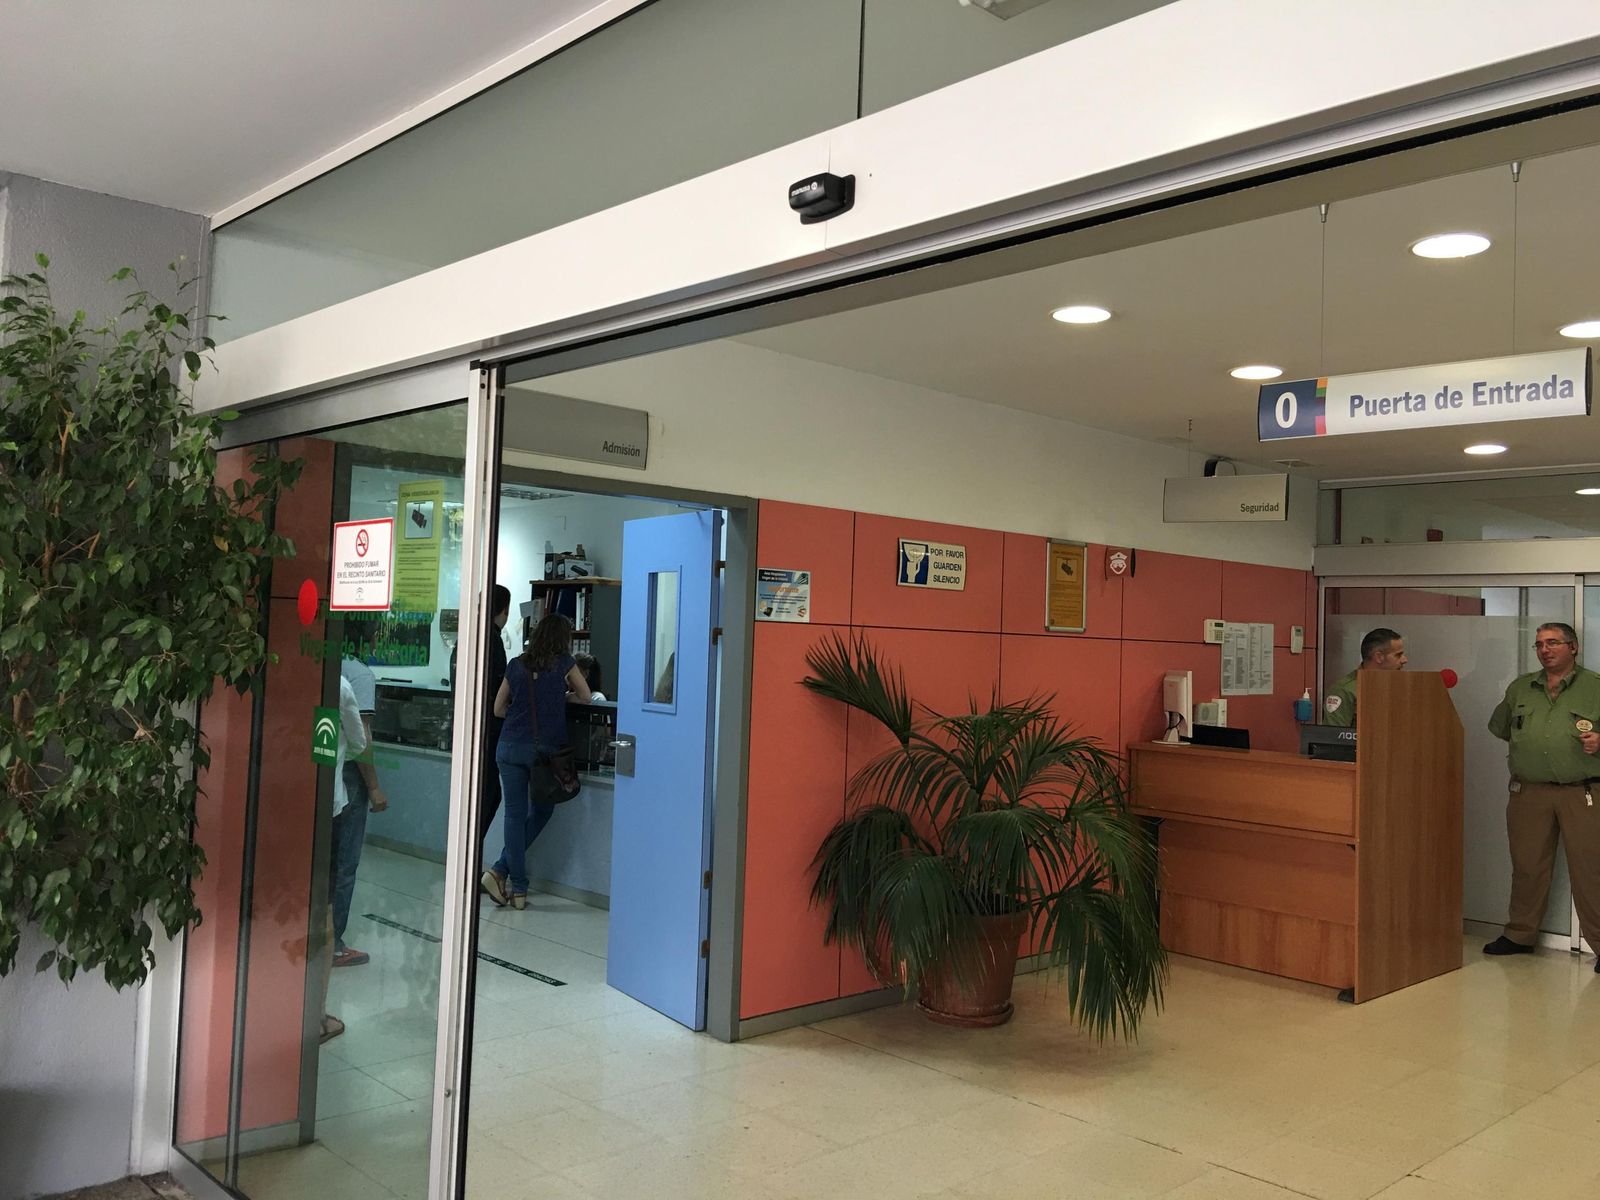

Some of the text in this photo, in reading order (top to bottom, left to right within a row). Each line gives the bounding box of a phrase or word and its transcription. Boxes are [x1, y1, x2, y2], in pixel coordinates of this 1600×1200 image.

[1274, 374, 1575, 429] 0 Puerta de Entrada
[602, 440, 641, 457] Admisión
[1240, 502, 1280, 514] Seguridad
[930, 548, 965, 559] POR FAVOR
[933, 561, 962, 572] GUARDEN
[932, 574, 960, 585] SILENCIO
